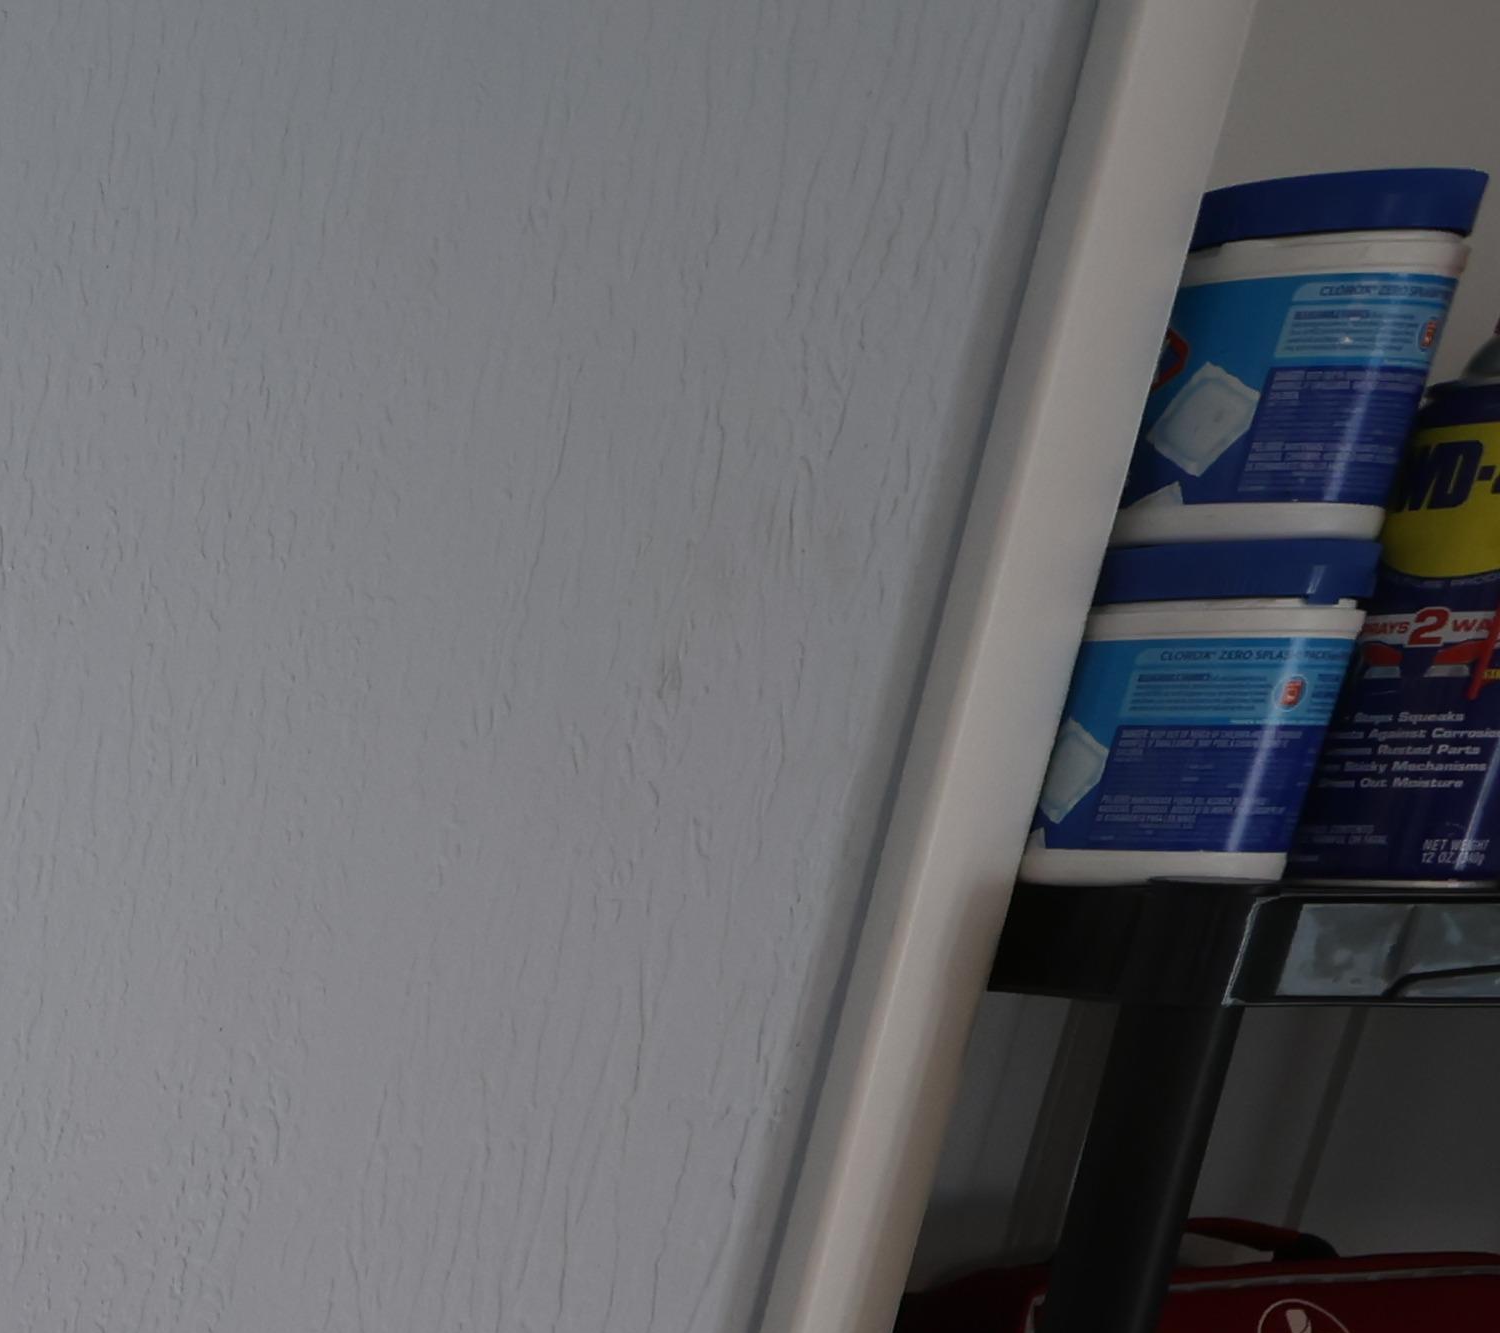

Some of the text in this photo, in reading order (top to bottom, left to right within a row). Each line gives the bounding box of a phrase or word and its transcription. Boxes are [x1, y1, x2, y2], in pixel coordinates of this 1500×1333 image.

[1393, 438, 1500, 513] WD-
[1407, 606, 1450, 646] 2
[1397, 711, 1466, 725] Squeaks
